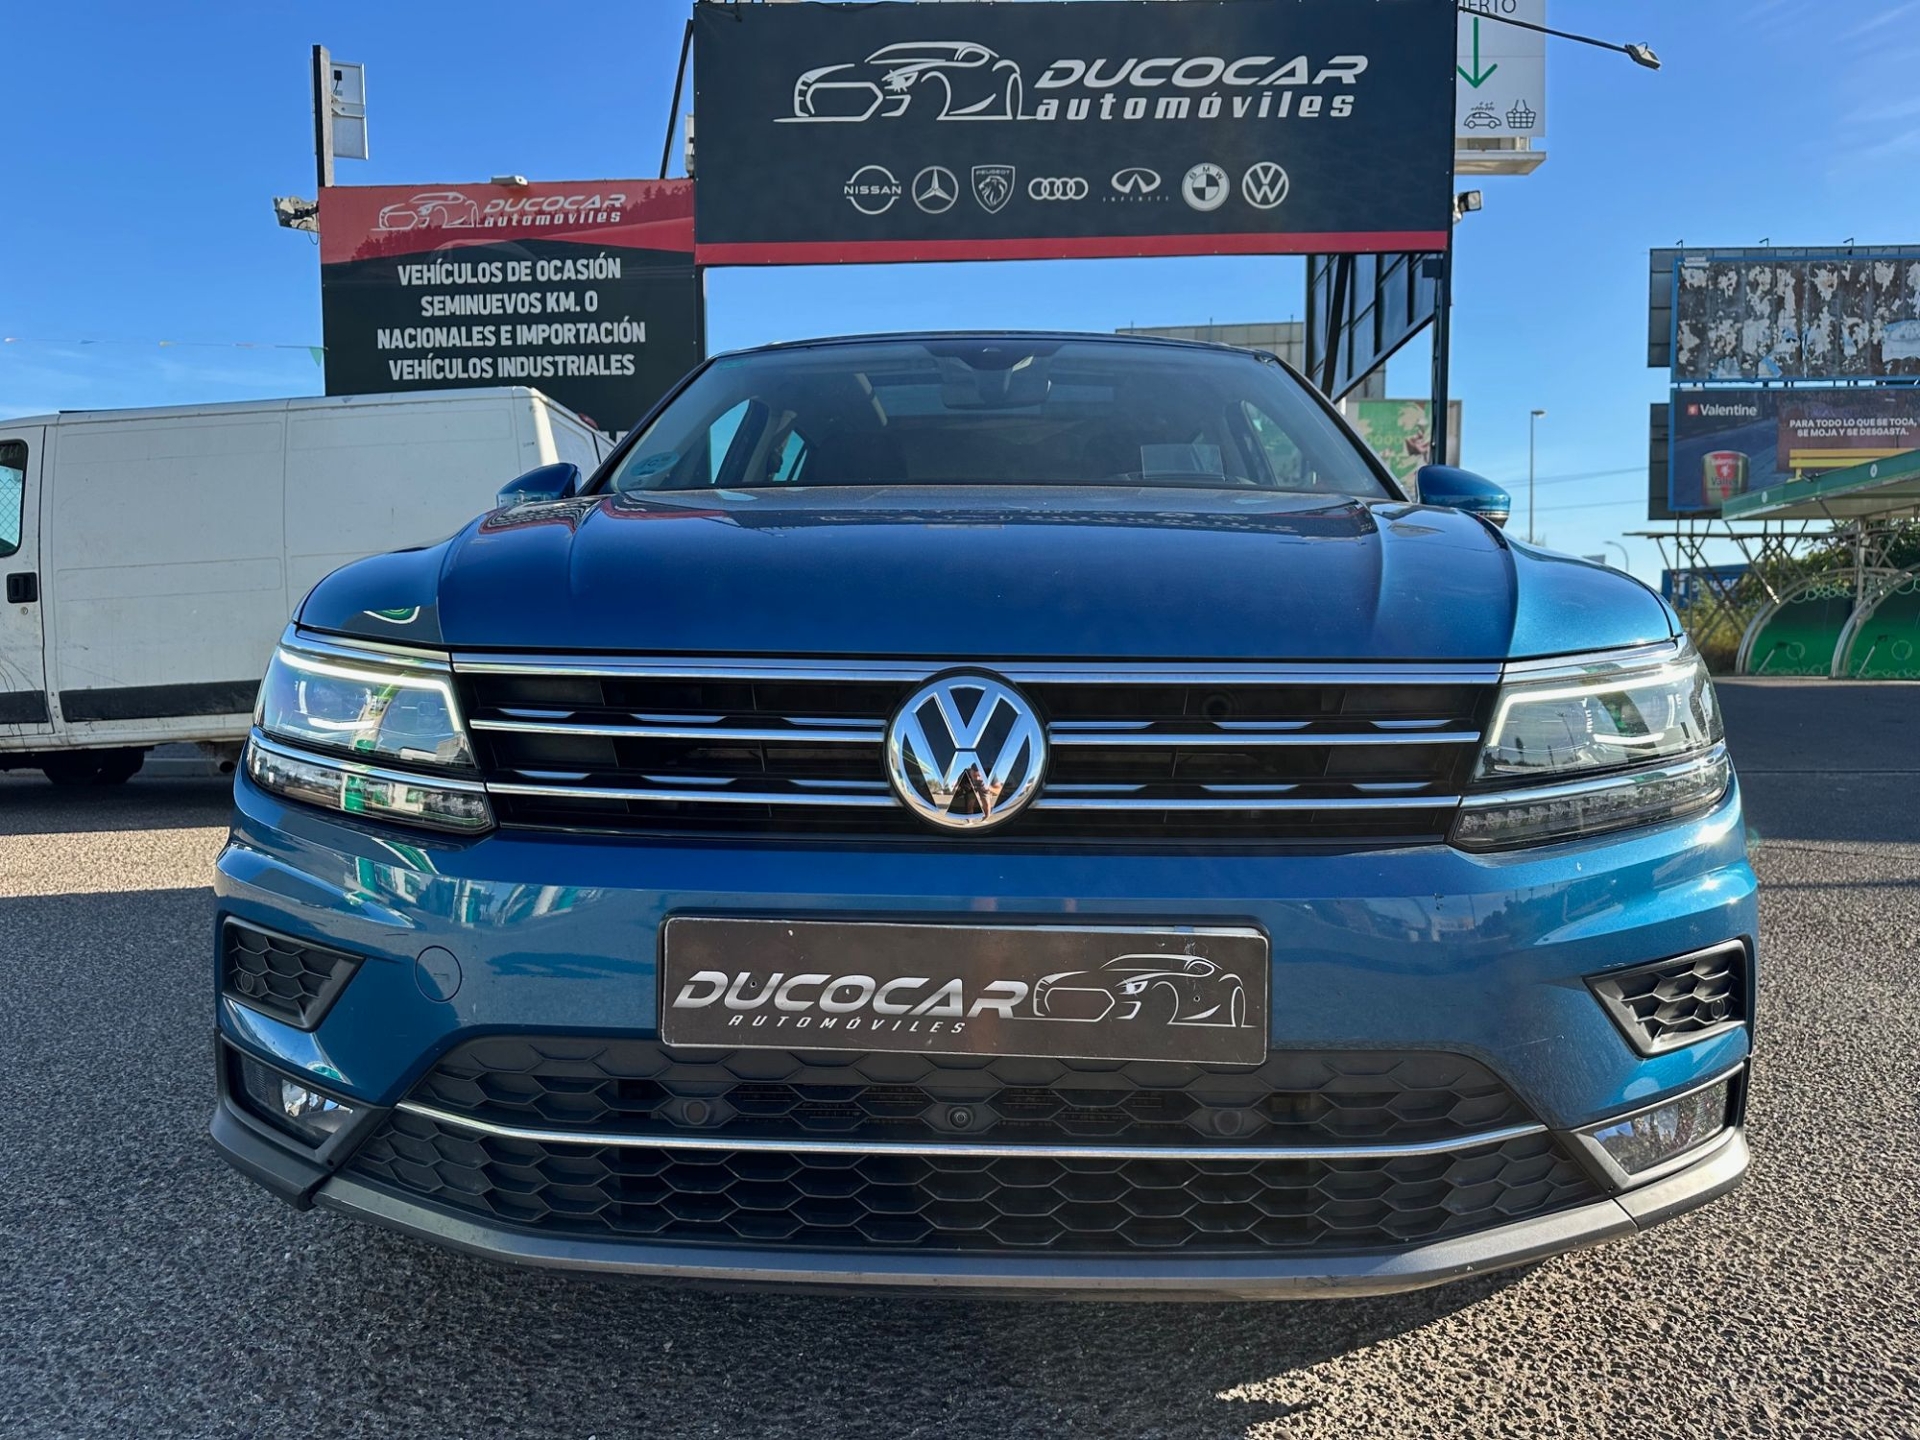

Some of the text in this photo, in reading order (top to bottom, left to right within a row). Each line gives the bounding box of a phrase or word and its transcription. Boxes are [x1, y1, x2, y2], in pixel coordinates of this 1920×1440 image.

[1034, 55, 1369, 89] DUCOCAR
[1035, 91, 1355, 120] automóviles
[1189, 165, 1225, 180] BMW
[844, 185, 902, 195] NISSAN
[484, 193, 627, 214] DUCOCAR
[397, 252, 622, 286] VEHÍCULOS DE OCASIÓN
[421, 292, 542, 317] SEMINUEVOS
[546, 291, 581, 313] KM.
[377, 315, 646, 350] NACIONALES E IMPORTACIÓN
[389, 353, 636, 381] VEHÍCULOS INDUSTRIALES
[1699, 403, 1758, 417] Valentine
[1789, 419, 1815, 428] PARA
[1816, 419, 1842, 428] TODO
[1843, 418, 1856, 427] LO
[1856, 418, 1875, 427] QUE
[1876, 418, 1888, 427] SE
[1810, 428, 1838, 437] MOJA
[1838, 428, 1845, 436] Y
[1846, 428, 1858, 436] SE
[672, 970, 1029, 1019] DUCOCAR
[728, 1015, 966, 1034] AUTOMÓVILES
